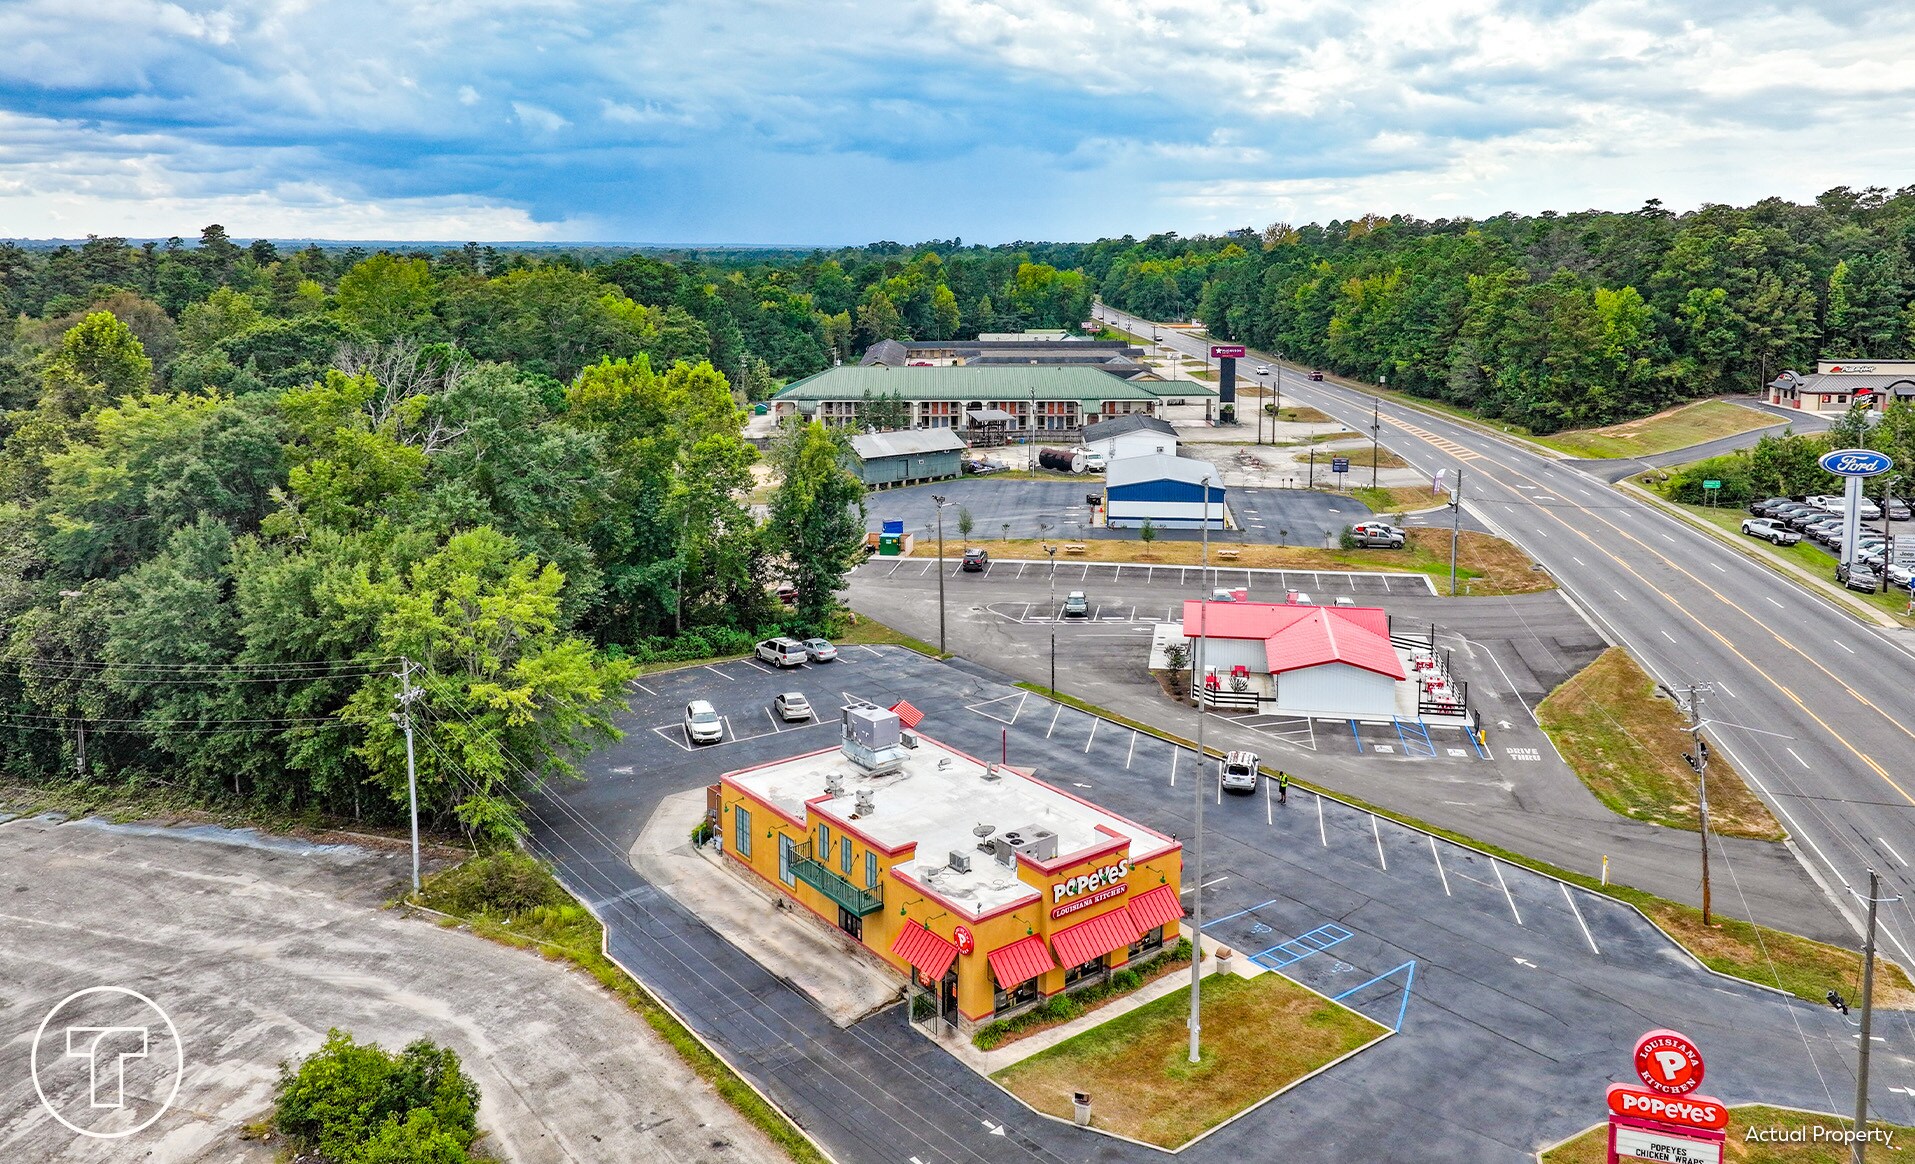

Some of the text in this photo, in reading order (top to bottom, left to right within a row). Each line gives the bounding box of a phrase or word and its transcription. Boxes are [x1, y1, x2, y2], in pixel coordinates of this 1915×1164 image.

[1837, 455, 1878, 471] Ford
[1505, 747, 1539, 755] DRIVE
[1056, 885, 1126, 918] LOUISIANA KITCHEN
[957, 932, 967, 948] P
[1639, 1038, 1700, 1067] LOUISIANA
[1654, 1050, 1687, 1080] P
[1641, 1070, 1697, 1094] KITCHEN
[1635, 1148, 1670, 1161] CHICKEN
[1650, 1142, 1688, 1157] POPEYES
